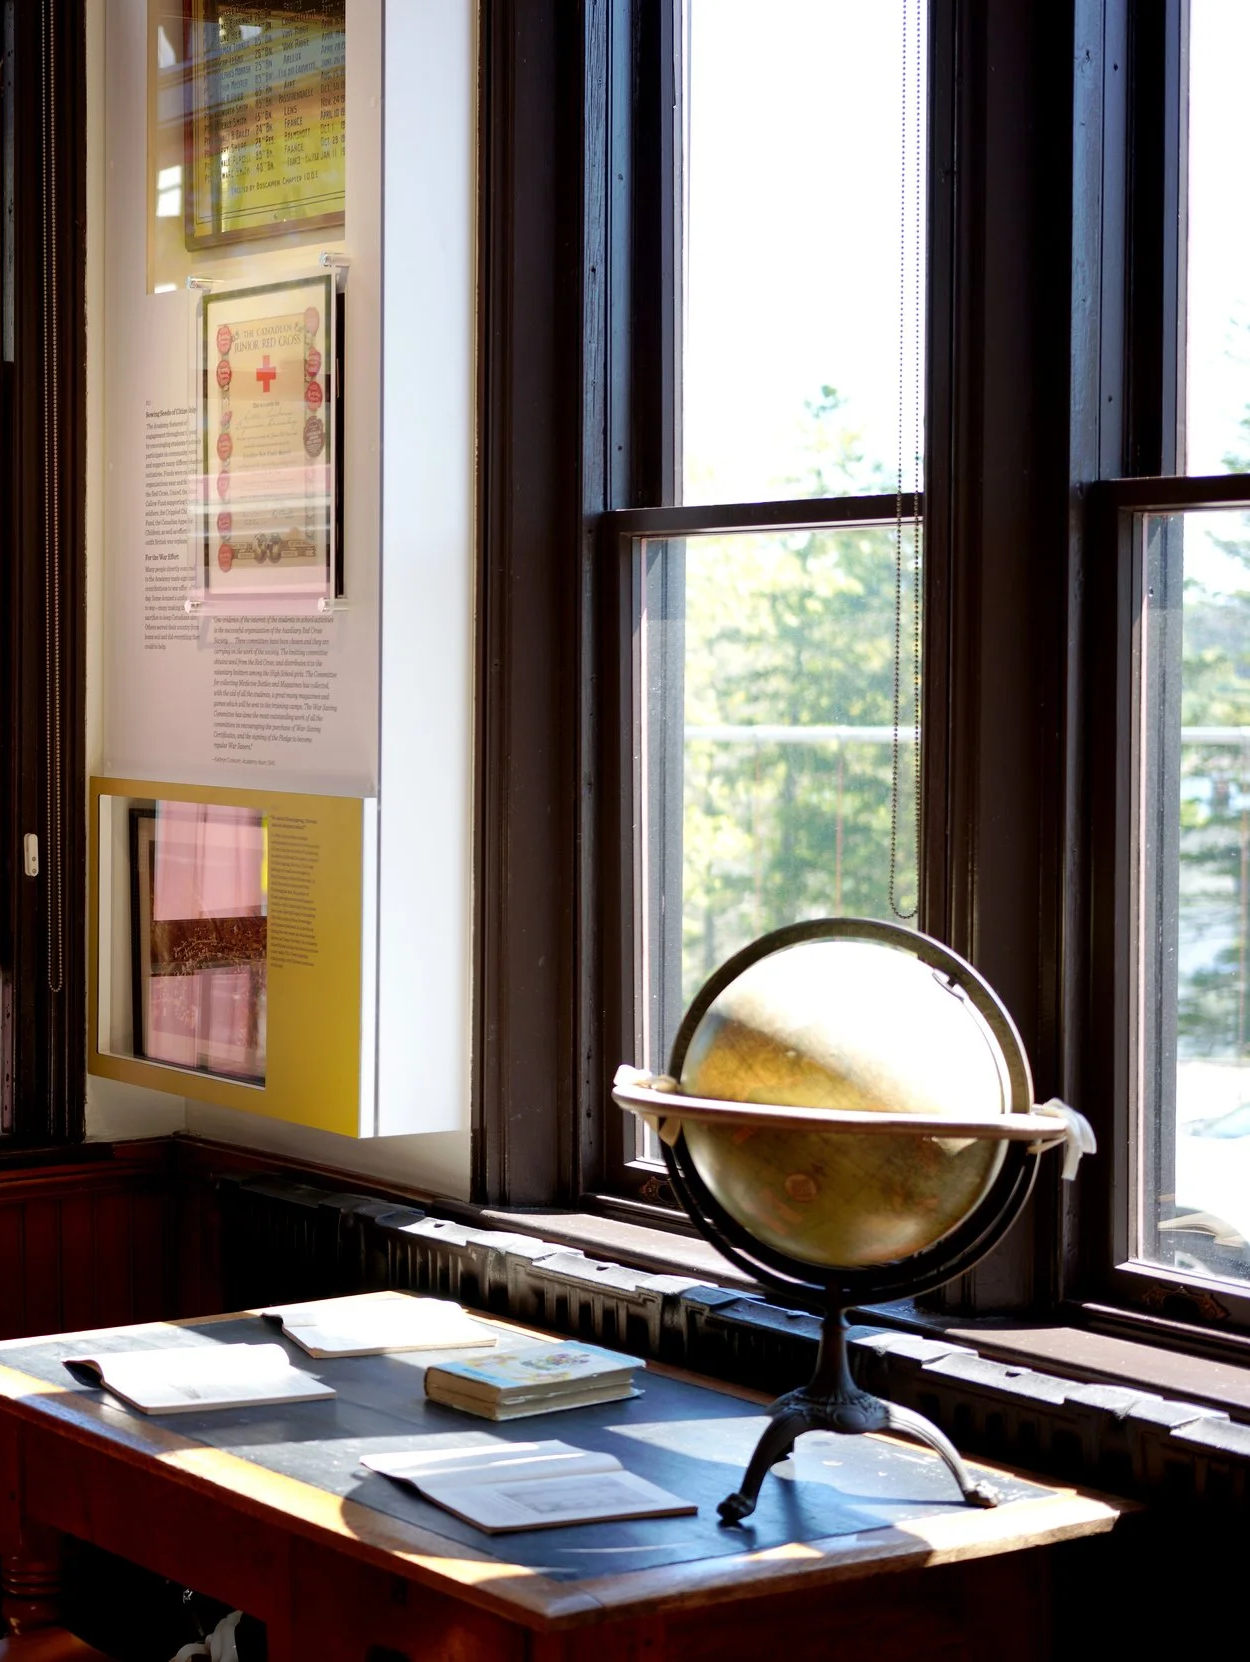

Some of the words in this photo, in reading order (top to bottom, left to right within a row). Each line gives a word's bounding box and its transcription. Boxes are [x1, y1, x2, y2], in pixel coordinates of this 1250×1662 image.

[233, 340, 259, 353] JUNIOR
[262, 338, 276, 348] RED
[278, 335, 301, 346] CROSS
